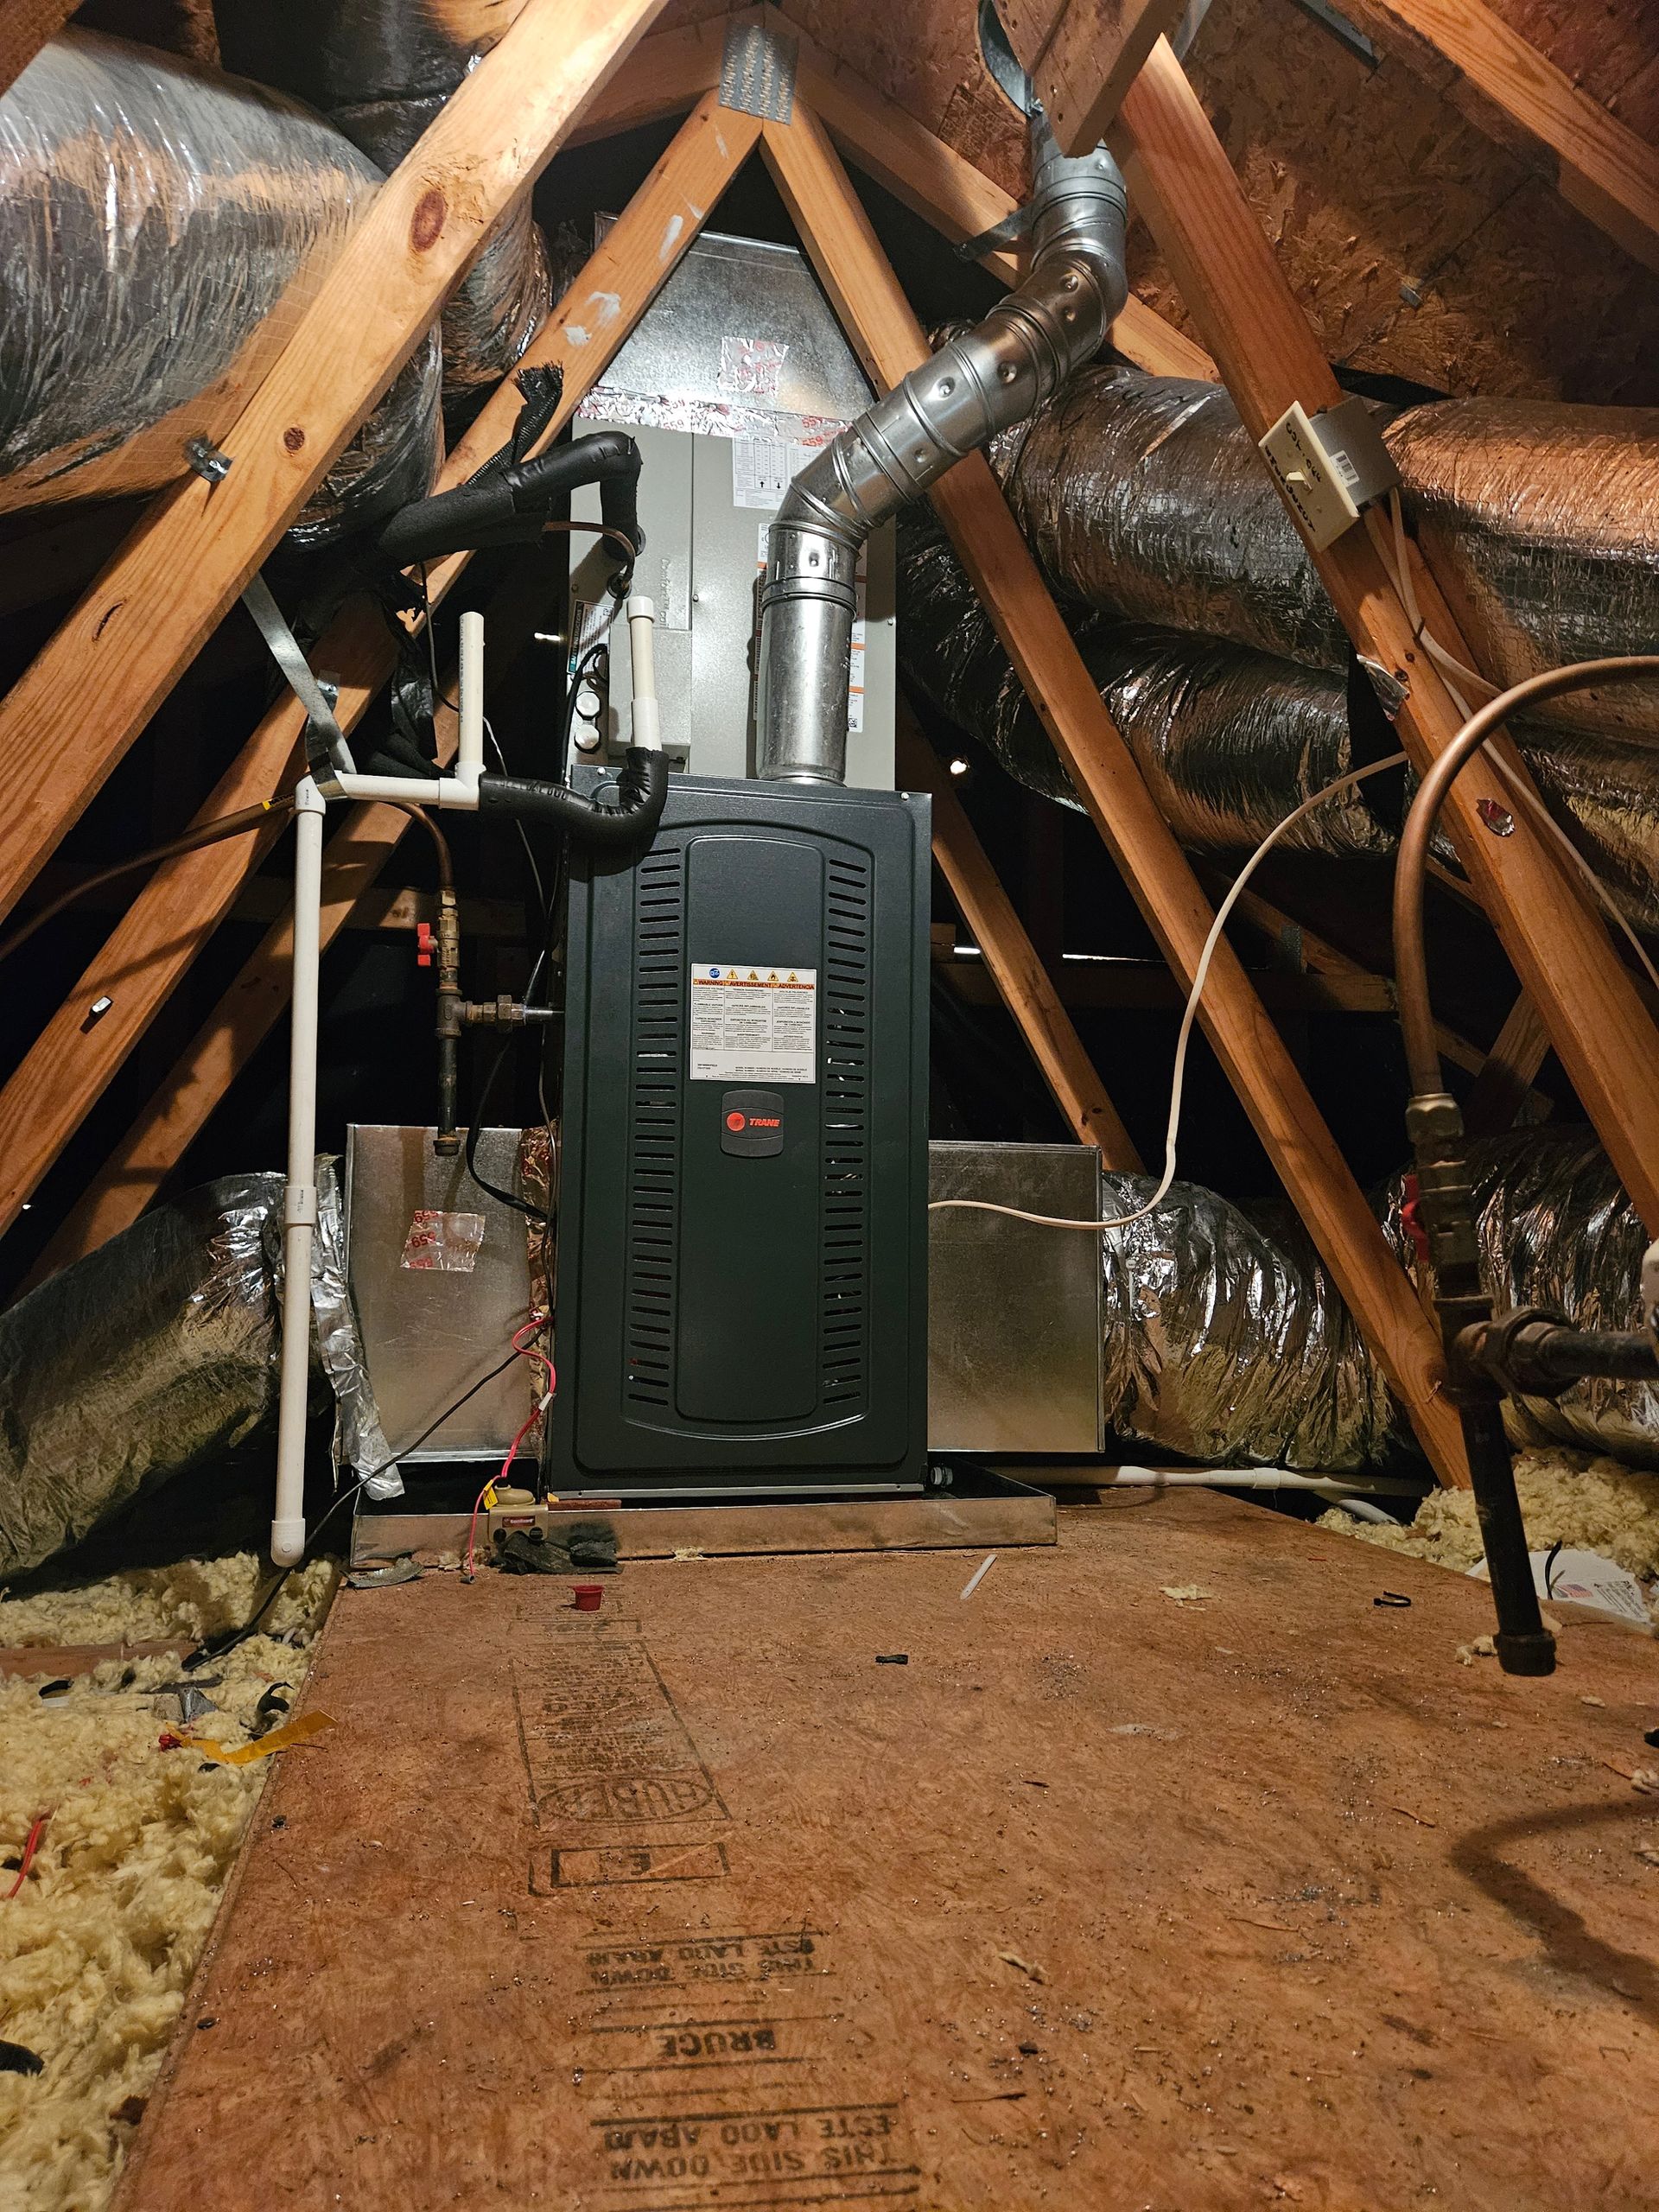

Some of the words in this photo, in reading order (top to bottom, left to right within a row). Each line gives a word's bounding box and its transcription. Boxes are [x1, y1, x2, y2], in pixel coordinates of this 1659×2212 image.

[663, 419, 685, 430] 559
[1265, 445, 1316, 532] EMERGENCY
[749, 1117, 780, 1127] TRANE
[411, 1231, 435, 1248] 559
[590, 1964, 675, 1985] DOWN
[656, 2029, 777, 2057] BRUCE
[606, 2124, 702, 2151] ABAJO
[820, 2114, 893, 2139] ESTE
[610, 2155, 710, 2181] DOWN
[724, 2148, 805, 2176] SIDE
[823, 2143, 891, 2170] THIS
